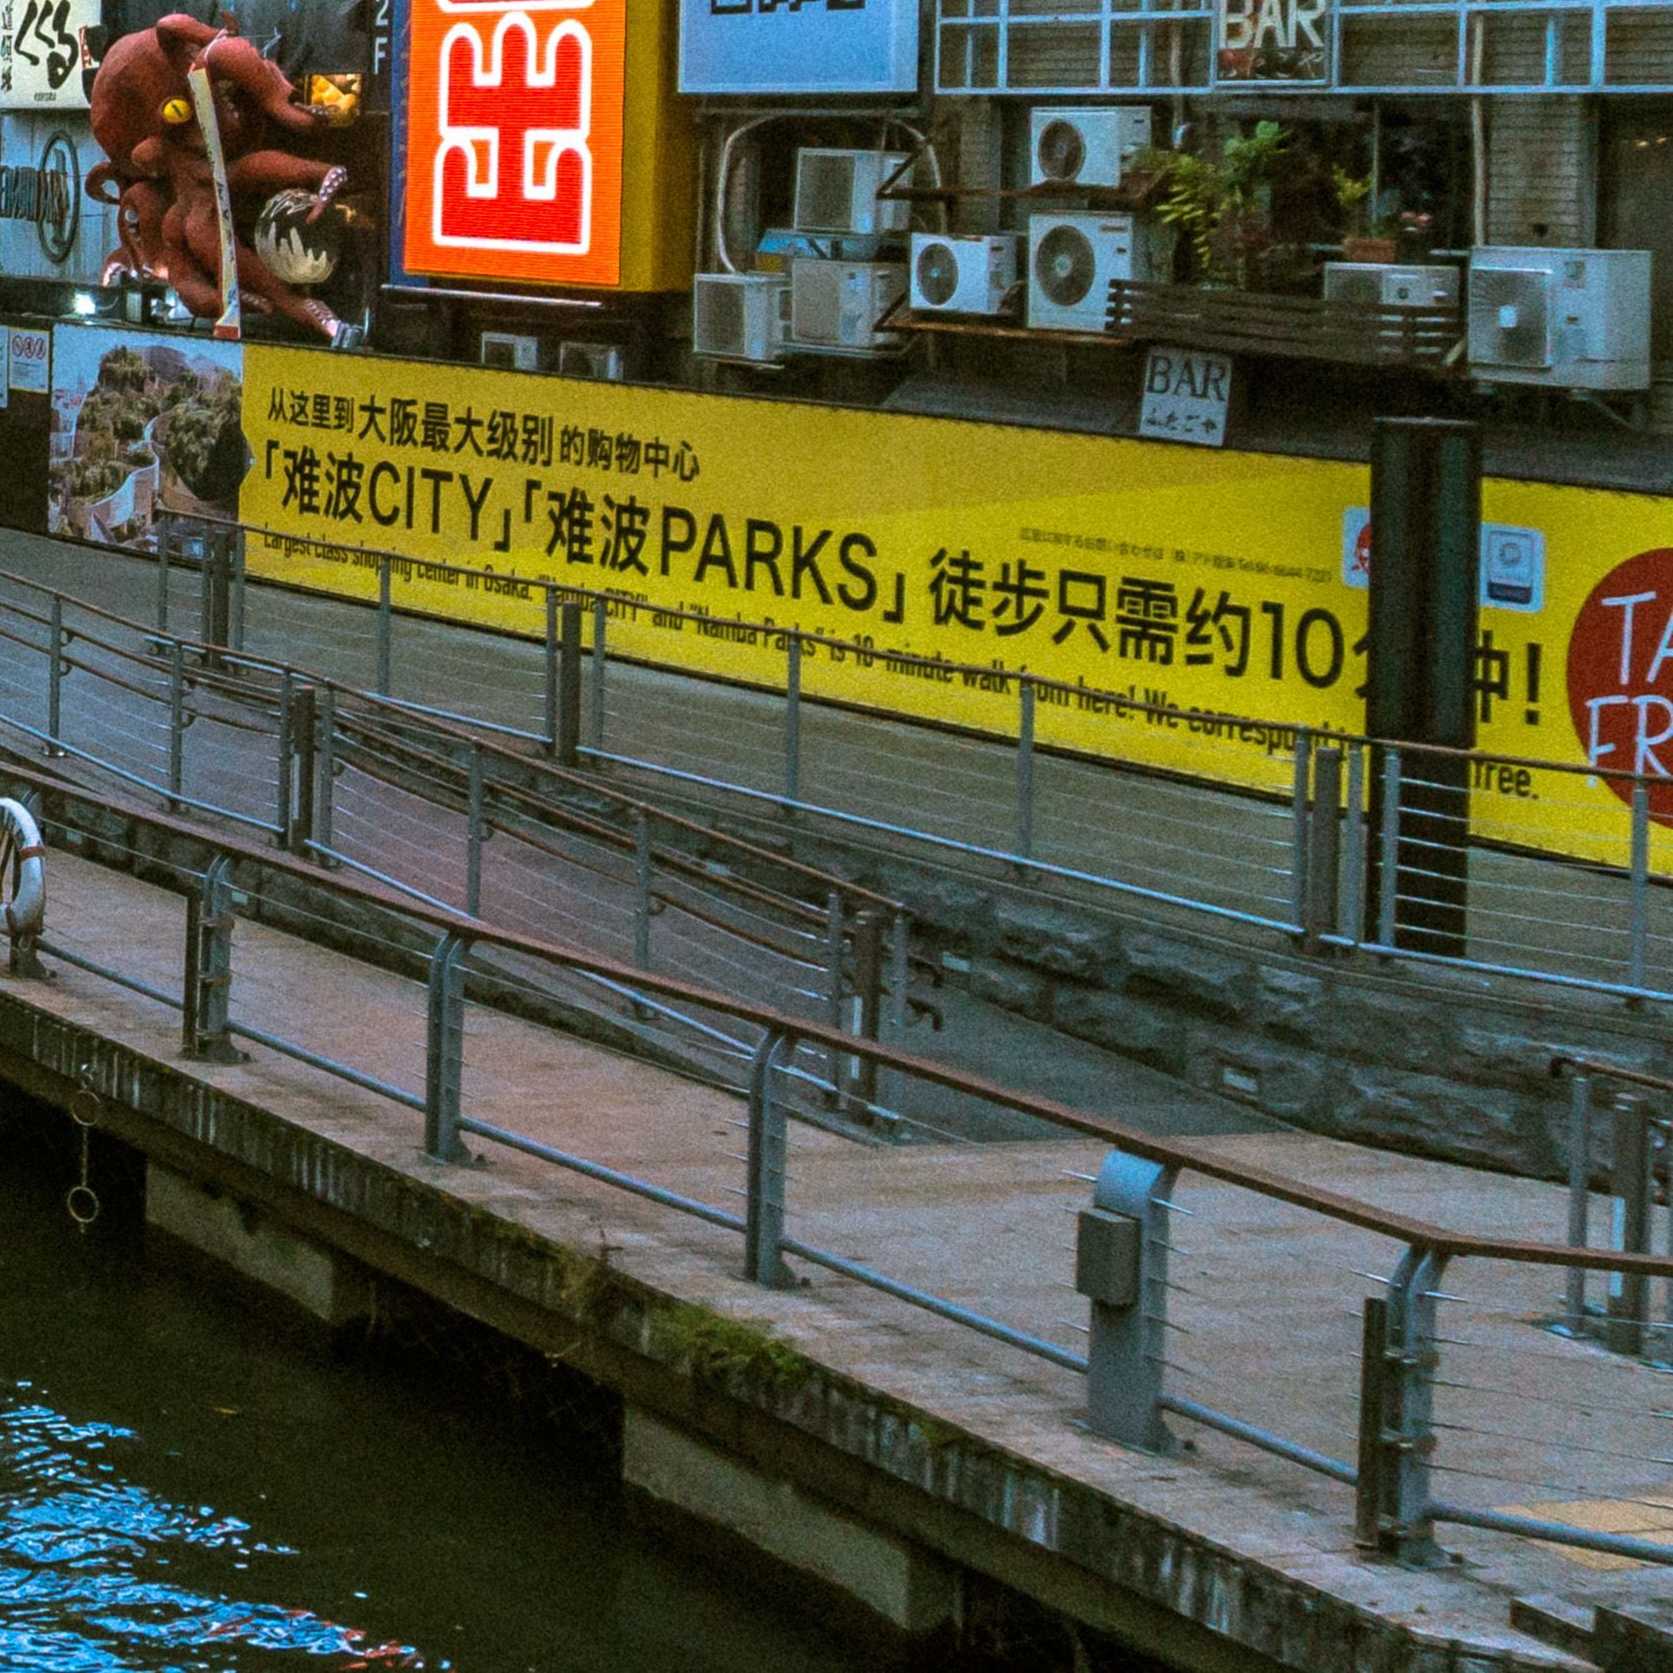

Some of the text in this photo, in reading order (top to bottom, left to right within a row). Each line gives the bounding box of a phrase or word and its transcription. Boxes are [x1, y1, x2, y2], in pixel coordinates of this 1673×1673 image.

[1146, 353, 1229, 405] BAR
[352, 539, 413, 584] shoping
[1187, 706, 1331, 756] correspod
